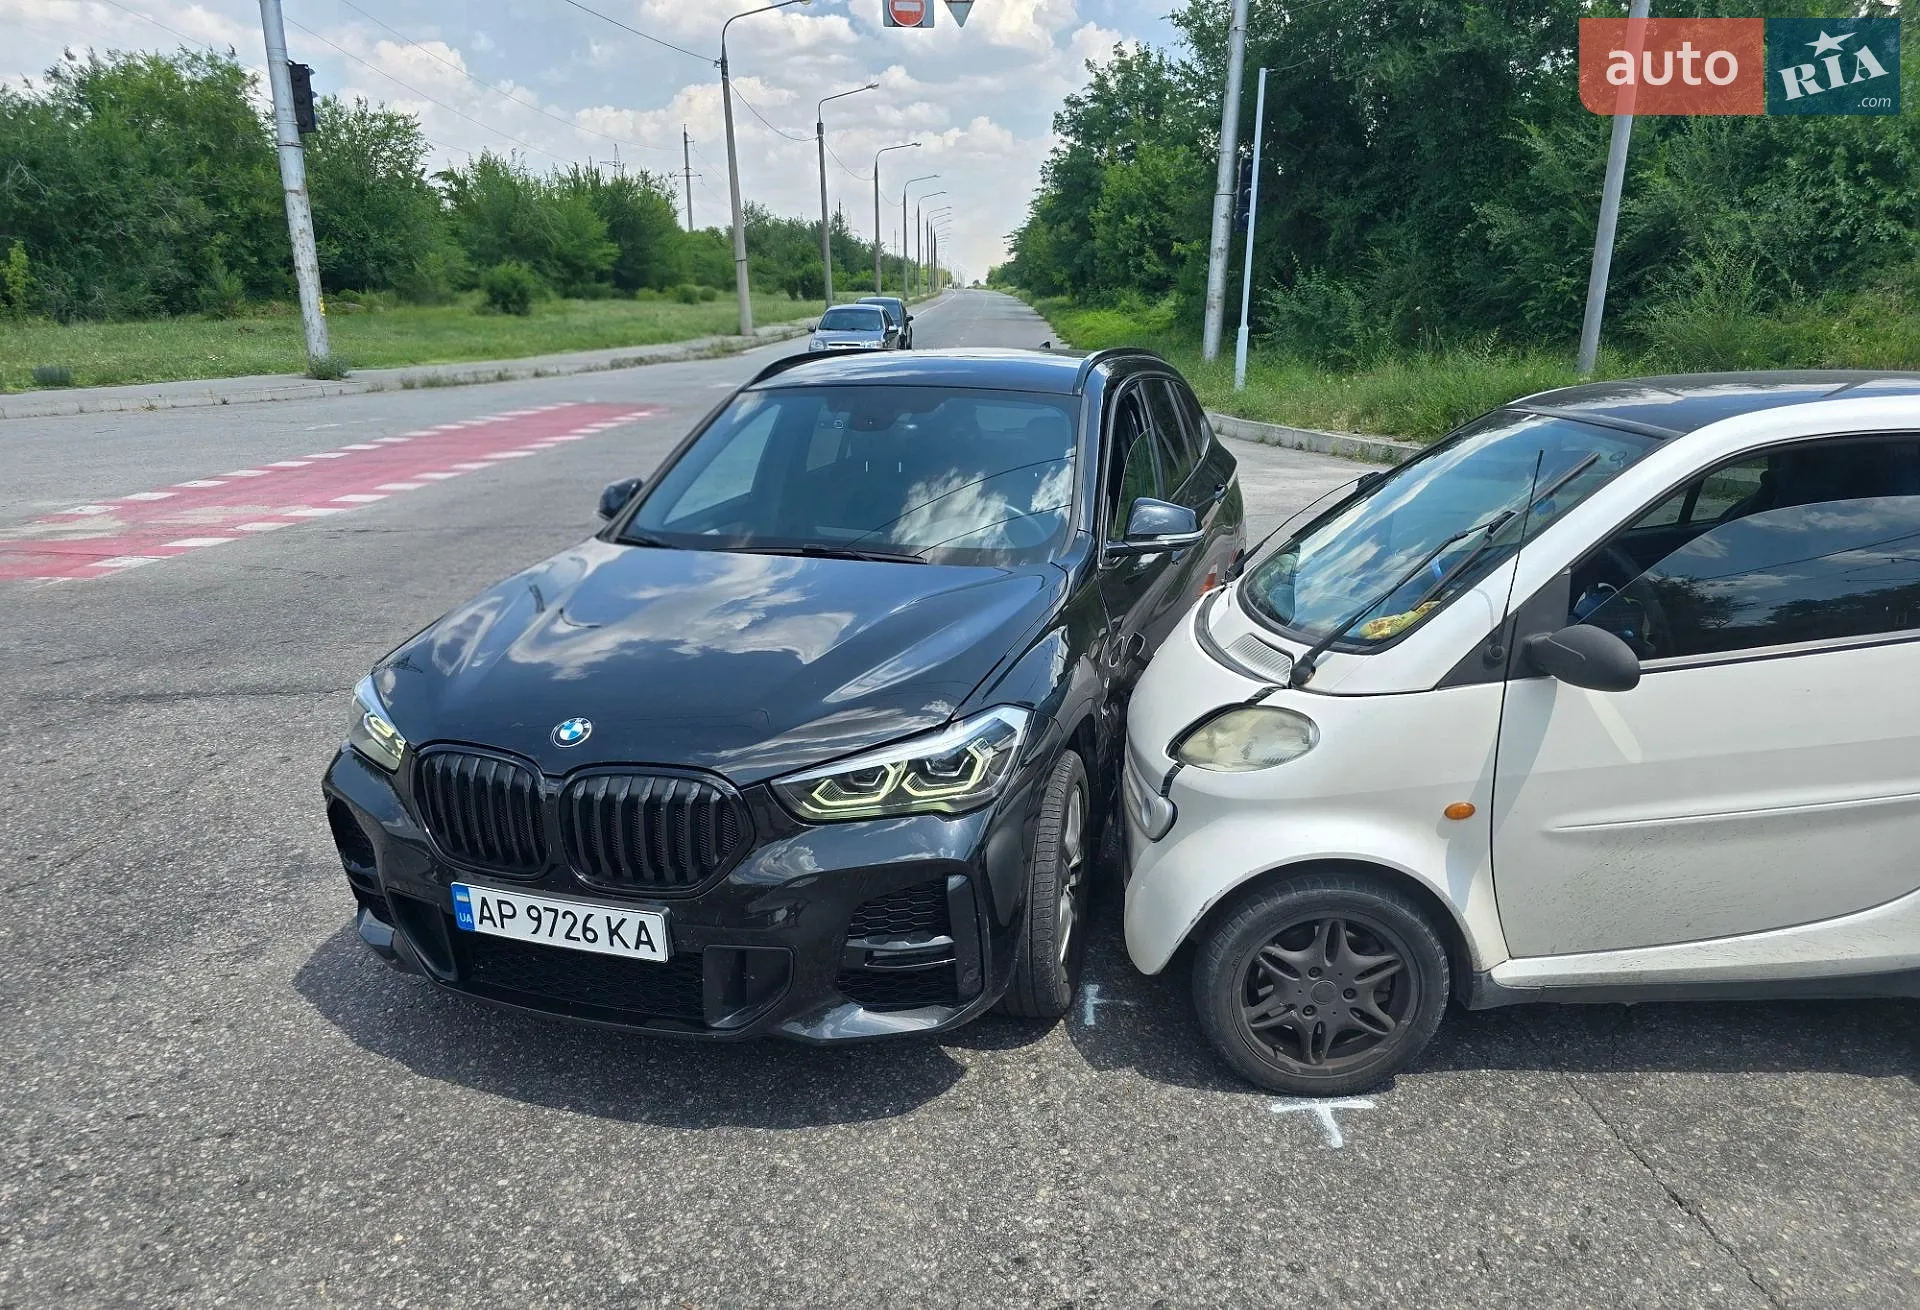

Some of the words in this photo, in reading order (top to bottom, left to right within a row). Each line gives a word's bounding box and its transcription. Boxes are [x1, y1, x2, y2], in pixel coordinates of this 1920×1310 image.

[459, 912, 473, 924] UA
[479, 896, 517, 929] AP
[526, 904, 599, 944] 9726
[606, 915, 657, 953] KA
